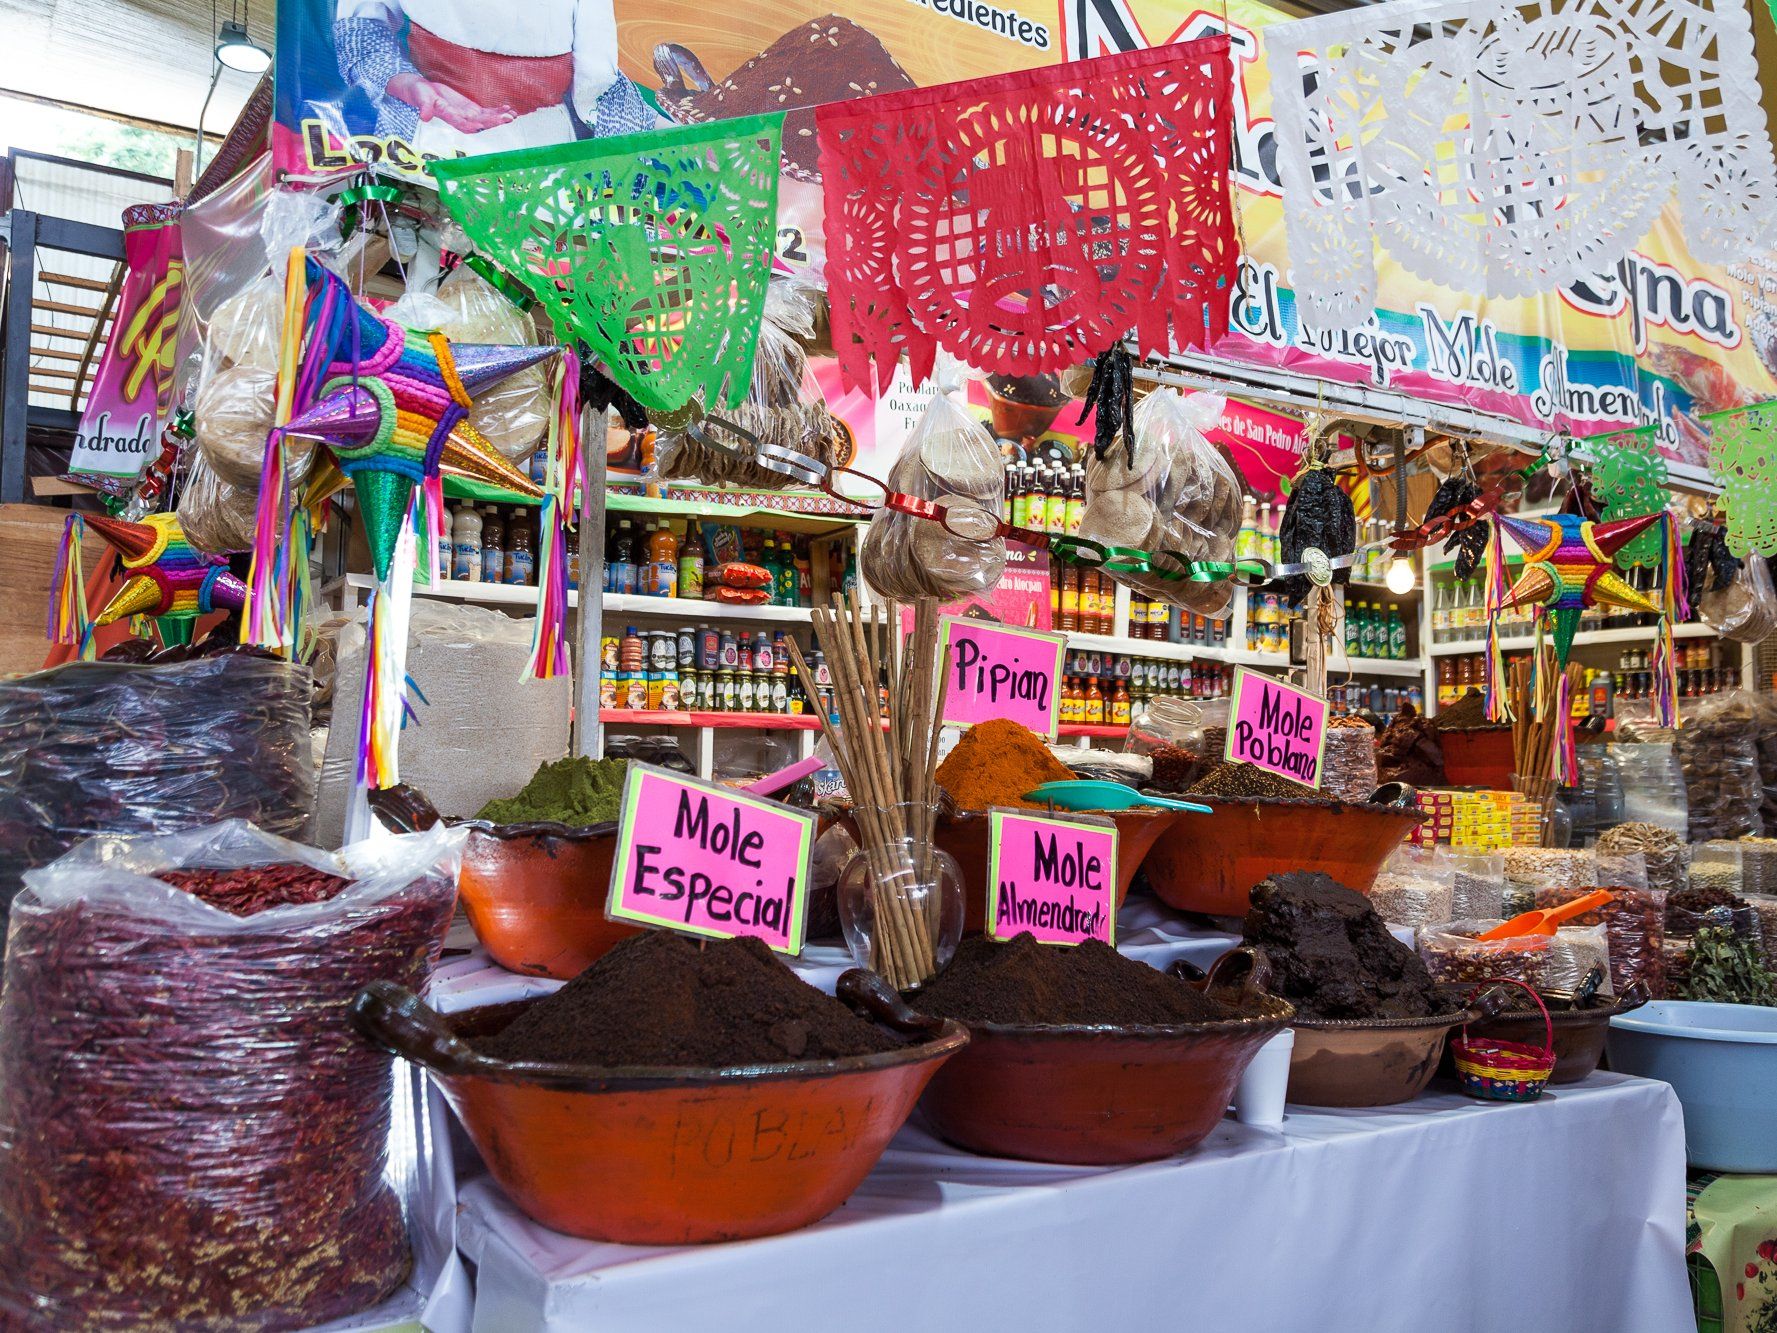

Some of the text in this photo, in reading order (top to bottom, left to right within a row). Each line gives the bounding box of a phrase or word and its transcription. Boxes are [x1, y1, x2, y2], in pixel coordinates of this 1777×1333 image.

[1231, 264, 1282, 341] El
[1420, 307, 1516, 391] Mole
[1234, 416, 1246, 437] de
[1246, 419, 1264, 443] San
[1265, 423, 1292, 452] Pedro
[955, 638, 1048, 711] Pipian
[1259, 683, 1313, 743] Mole
[1236, 720, 1317, 781] Poblano
[674, 789, 764, 869] Mole
[1033, 830, 1102, 890] Mole
[633, 844, 796, 938] Especial
